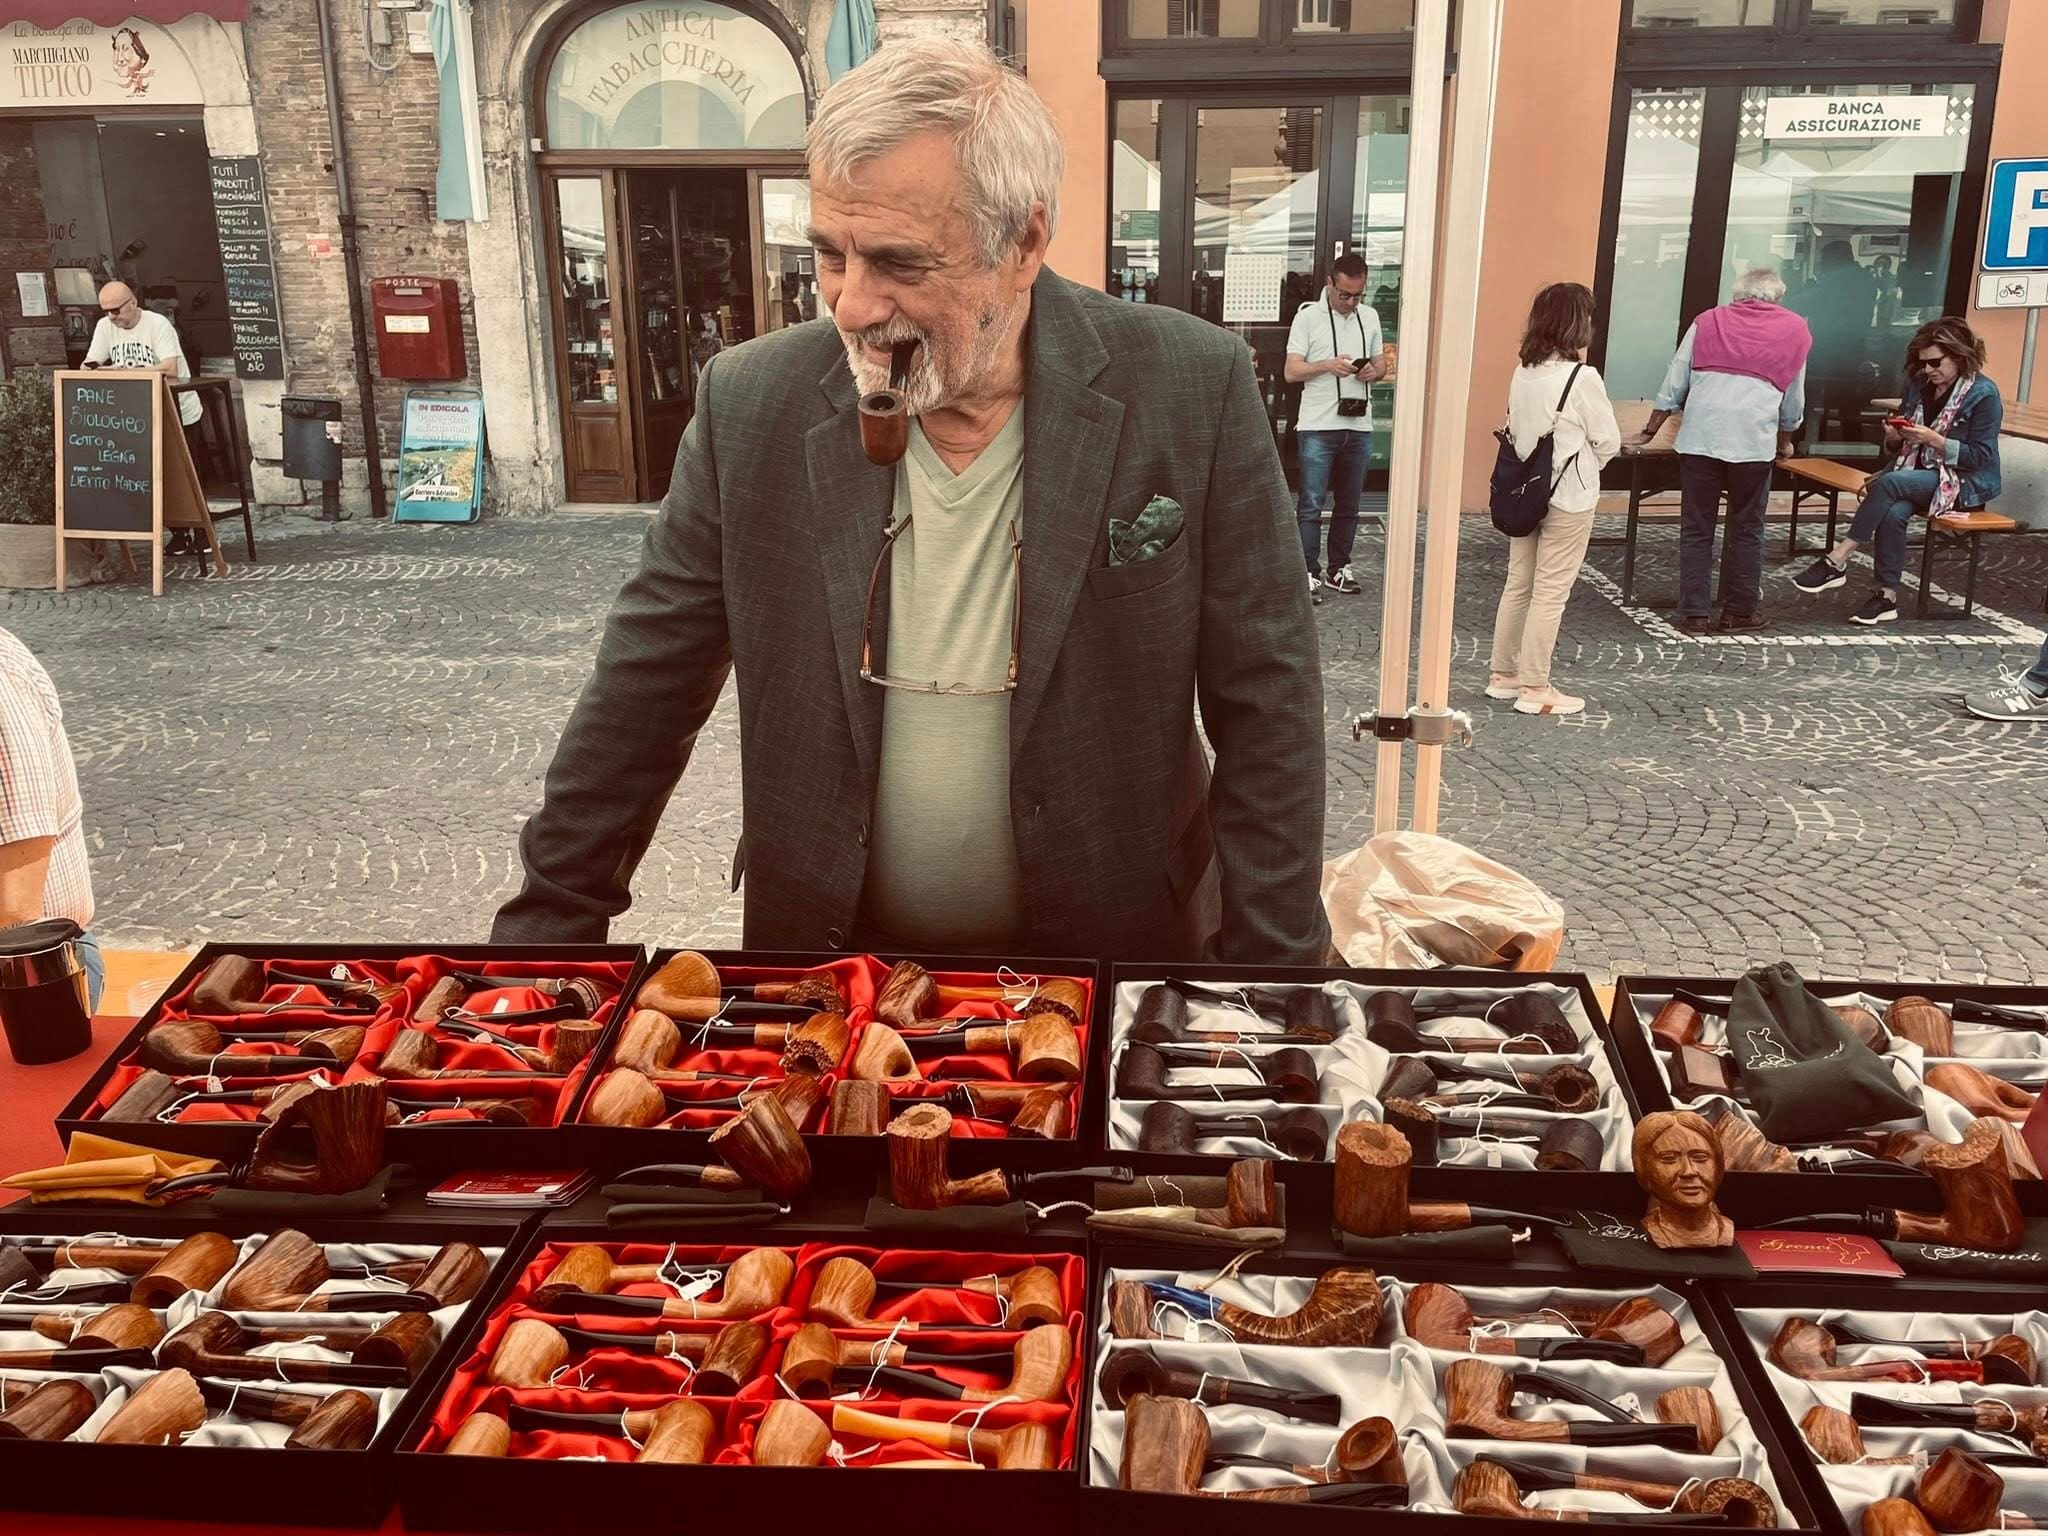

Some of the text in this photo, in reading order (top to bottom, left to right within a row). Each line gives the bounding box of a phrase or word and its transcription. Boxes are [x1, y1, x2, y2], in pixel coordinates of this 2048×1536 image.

[14, 23, 28, 38] La
[76, 21, 96, 36] del
[624, 8, 716, 42] ANTICA
[12, 46, 90, 65] MARCHIGIANO
[14, 64, 93, 98] TIPICO
[588, 41, 755, 107] TABACCHERIA
[1827, 102, 1884, 115] BANCA
[1785, 118, 1922, 133] ASSICURAZIONE
[385, 278, 420, 287] POSTE
[76, 387, 116, 406] PANE
[418, 404, 470, 413] IN EDICOLA
[68, 433, 104, 446] COTTO
[98, 448, 136, 464] LEGNA
[2003, 695, 2031, 713] N
